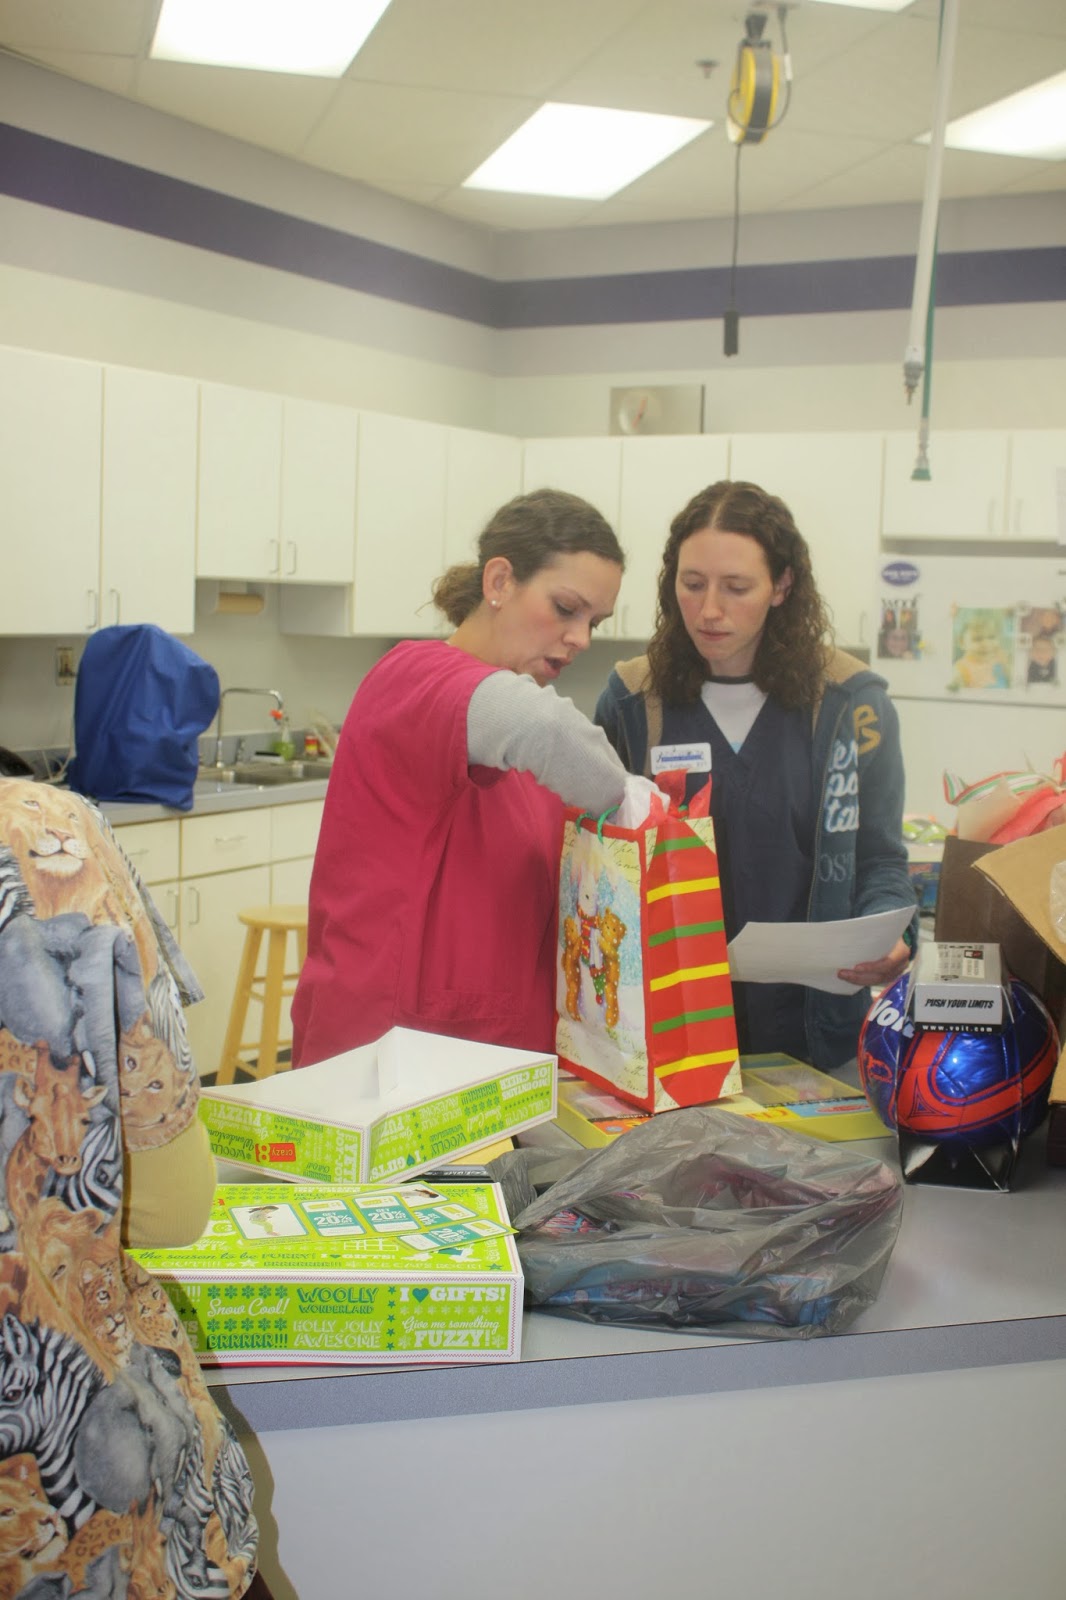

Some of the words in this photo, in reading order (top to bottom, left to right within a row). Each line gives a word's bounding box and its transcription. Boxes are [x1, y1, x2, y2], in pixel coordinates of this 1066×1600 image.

[924, 998, 947, 1008] PUSH
[947, 999, 968, 1008] YOUR
[968, 1000, 994, 1009] LIMITS
[533, 1067, 550, 1081] OF
[271, 1147, 293, 1156] crazy
[430, 1132, 467, 1157] WOOLLY
[297, 1286, 379, 1304] WOOLLY
[400, 1287, 410, 1301] I
[429, 1286, 507, 1301] GIFTS!
[207, 1298, 246, 1317] Snow
[248, 1297, 291, 1316] Cool!
[299, 1304, 374, 1314] WONDERLAND
[293, 1320, 337, 1333] HOLLY
[341, 1320, 384, 1333] JOLLY
[403, 1316, 428, 1334] Give
[431, 1321, 446, 1329] me
[449, 1315, 501, 1335] something
[293, 1333, 382, 1348] AWESOME
[414, 1330, 491, 1348] FUZZY!
